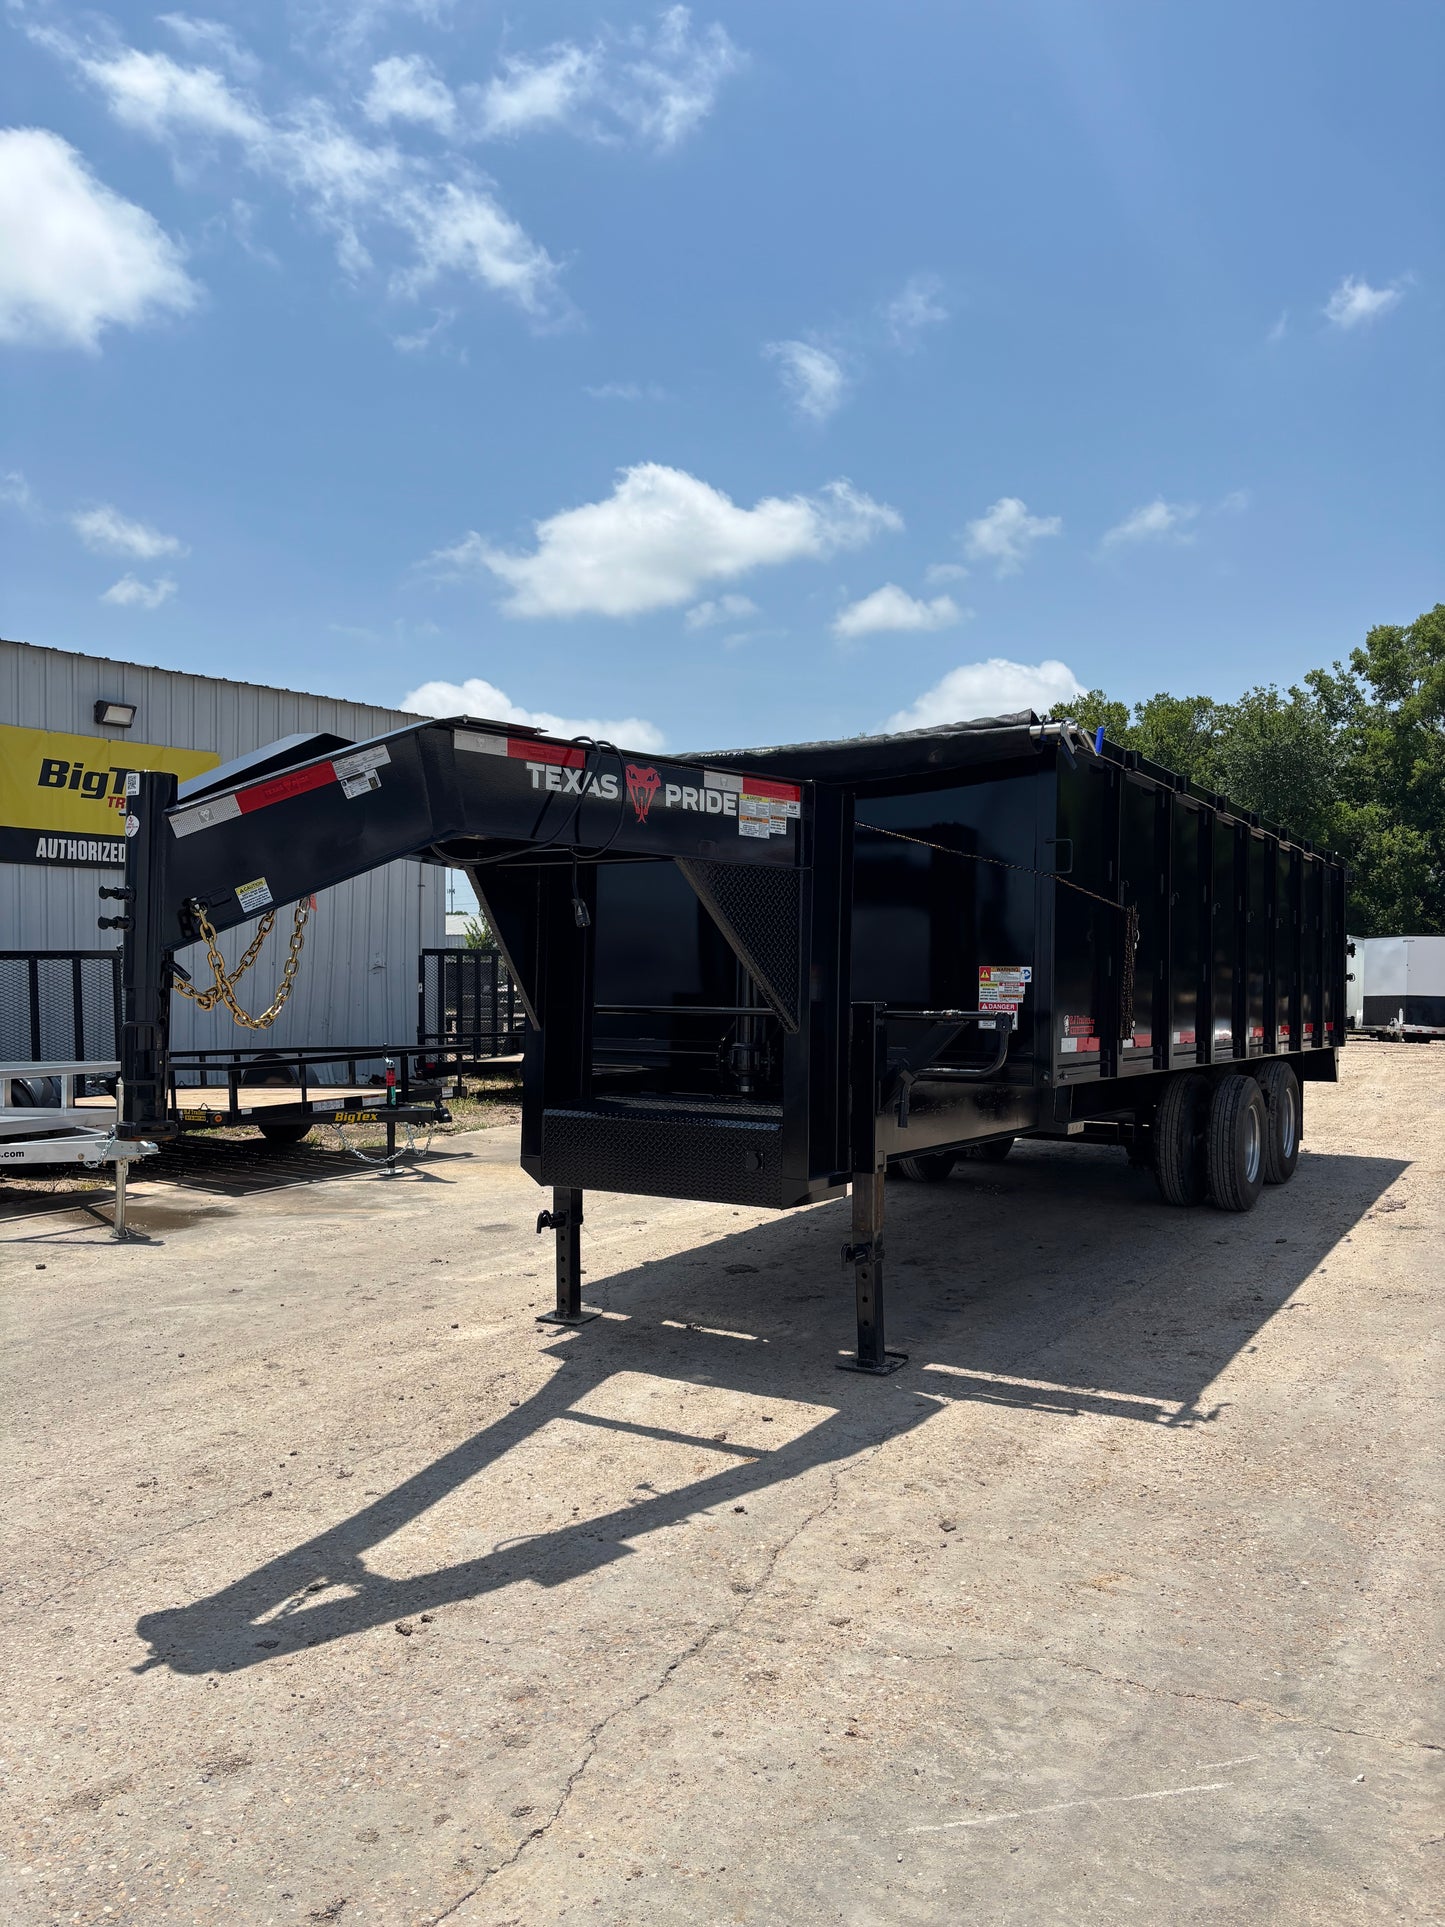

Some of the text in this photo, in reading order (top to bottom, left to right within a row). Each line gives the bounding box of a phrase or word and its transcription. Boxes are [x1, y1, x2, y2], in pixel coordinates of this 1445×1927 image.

[526, 762, 619, 800] TEXAS
[665, 783, 737, 816] PRIDE
[36, 837, 125, 863] AUTHORIZED
[335, 1111, 378, 1124] BigTex
